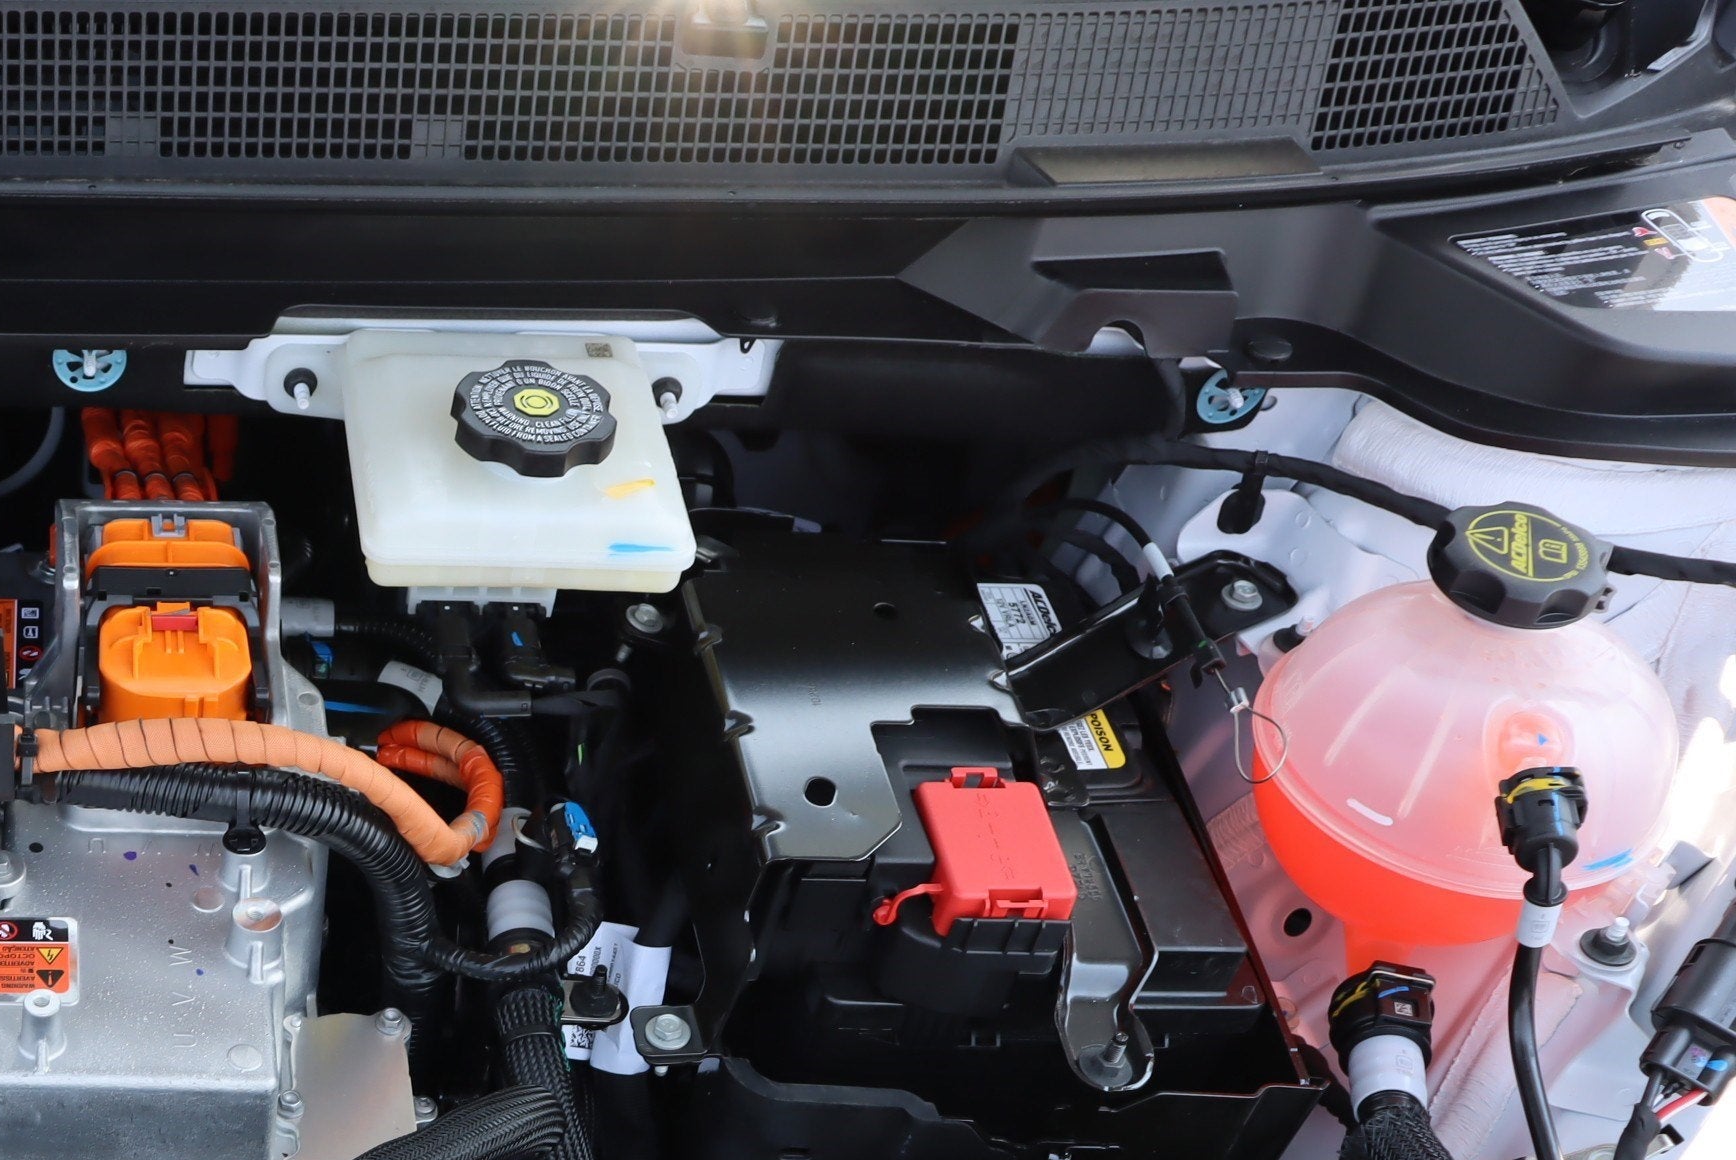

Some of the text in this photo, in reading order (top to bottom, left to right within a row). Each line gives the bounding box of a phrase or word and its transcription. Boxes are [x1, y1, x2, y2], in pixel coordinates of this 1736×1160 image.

[1510, 513, 1529, 575] ACDelco
[1090, 713, 1114, 752] POISON
[168, 946, 193, 967] W
